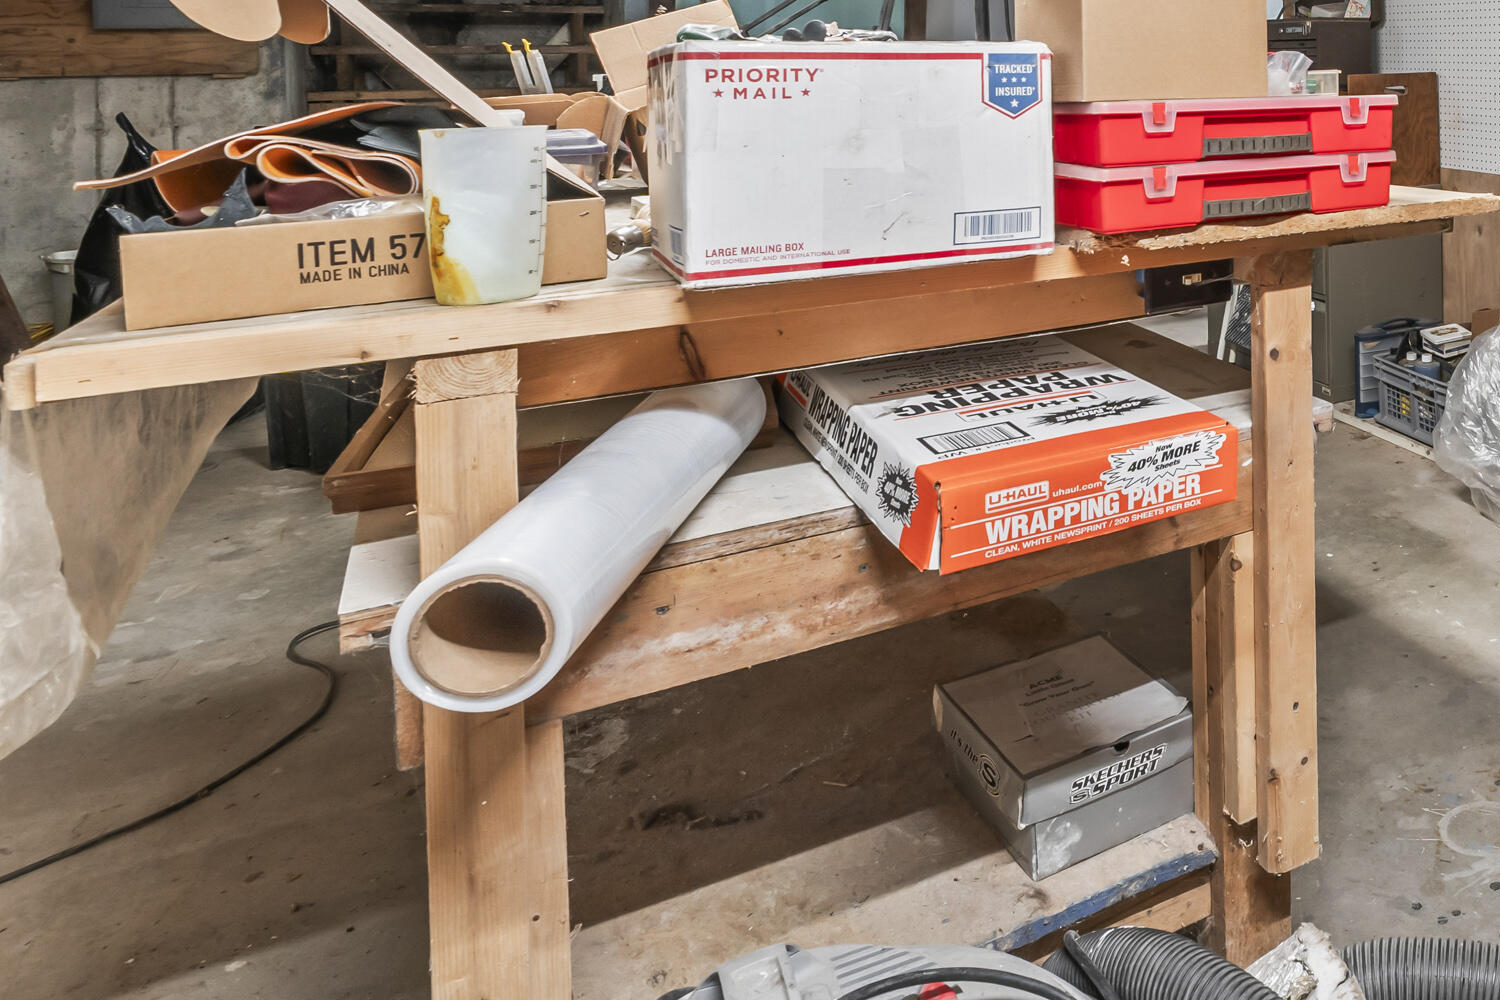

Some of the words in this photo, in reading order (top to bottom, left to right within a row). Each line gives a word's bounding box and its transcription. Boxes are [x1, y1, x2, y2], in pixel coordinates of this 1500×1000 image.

[705, 68, 819, 83] PRIORITY
[733, 87, 792, 99] MAIL
[297, 237, 375, 269] ITEM
[705, 247, 738, 258] LARGE
[741, 244, 782, 256] MAILING
[785, 242, 805, 252] BOX
[299, 269, 342, 284] MADE
[348, 267, 361, 279] IN
[369, 263, 409, 278] CHINA
[879, 375, 977, 395] NEWSPRINT
[894, 374, 1127, 416] WRAPPING
[926, 372, 1068, 399] PAPER
[808, 384, 851, 450] WRAPPING
[846, 423, 878, 478] PAPER
[1127, 455, 1159, 473] 40%
[1161, 439, 1201, 461] MORE
[1155, 442, 1173, 453] Now
[1154, 458, 1181, 472] Sheets
[1052, 480, 1103, 498] uhaul.com
[985, 492, 1120, 545] WRAPPING
[1125, 473, 1201, 511] PAPER
[985, 544, 1020, 558] CLEAN,
[1022, 536, 1053, 550] WHITE
[1054, 521, 1107, 542] NEWSPRINT
[1113, 516, 1130, 527] 200
[1131, 508, 1164, 521] SHEETS
[1165, 503, 1183, 513] PER
[1183, 498, 1202, 509] BOX
[964, 744, 979, 764] the
[1071, 743, 1167, 791] SKECHERS
[1092, 757, 1161, 796] SPORT
